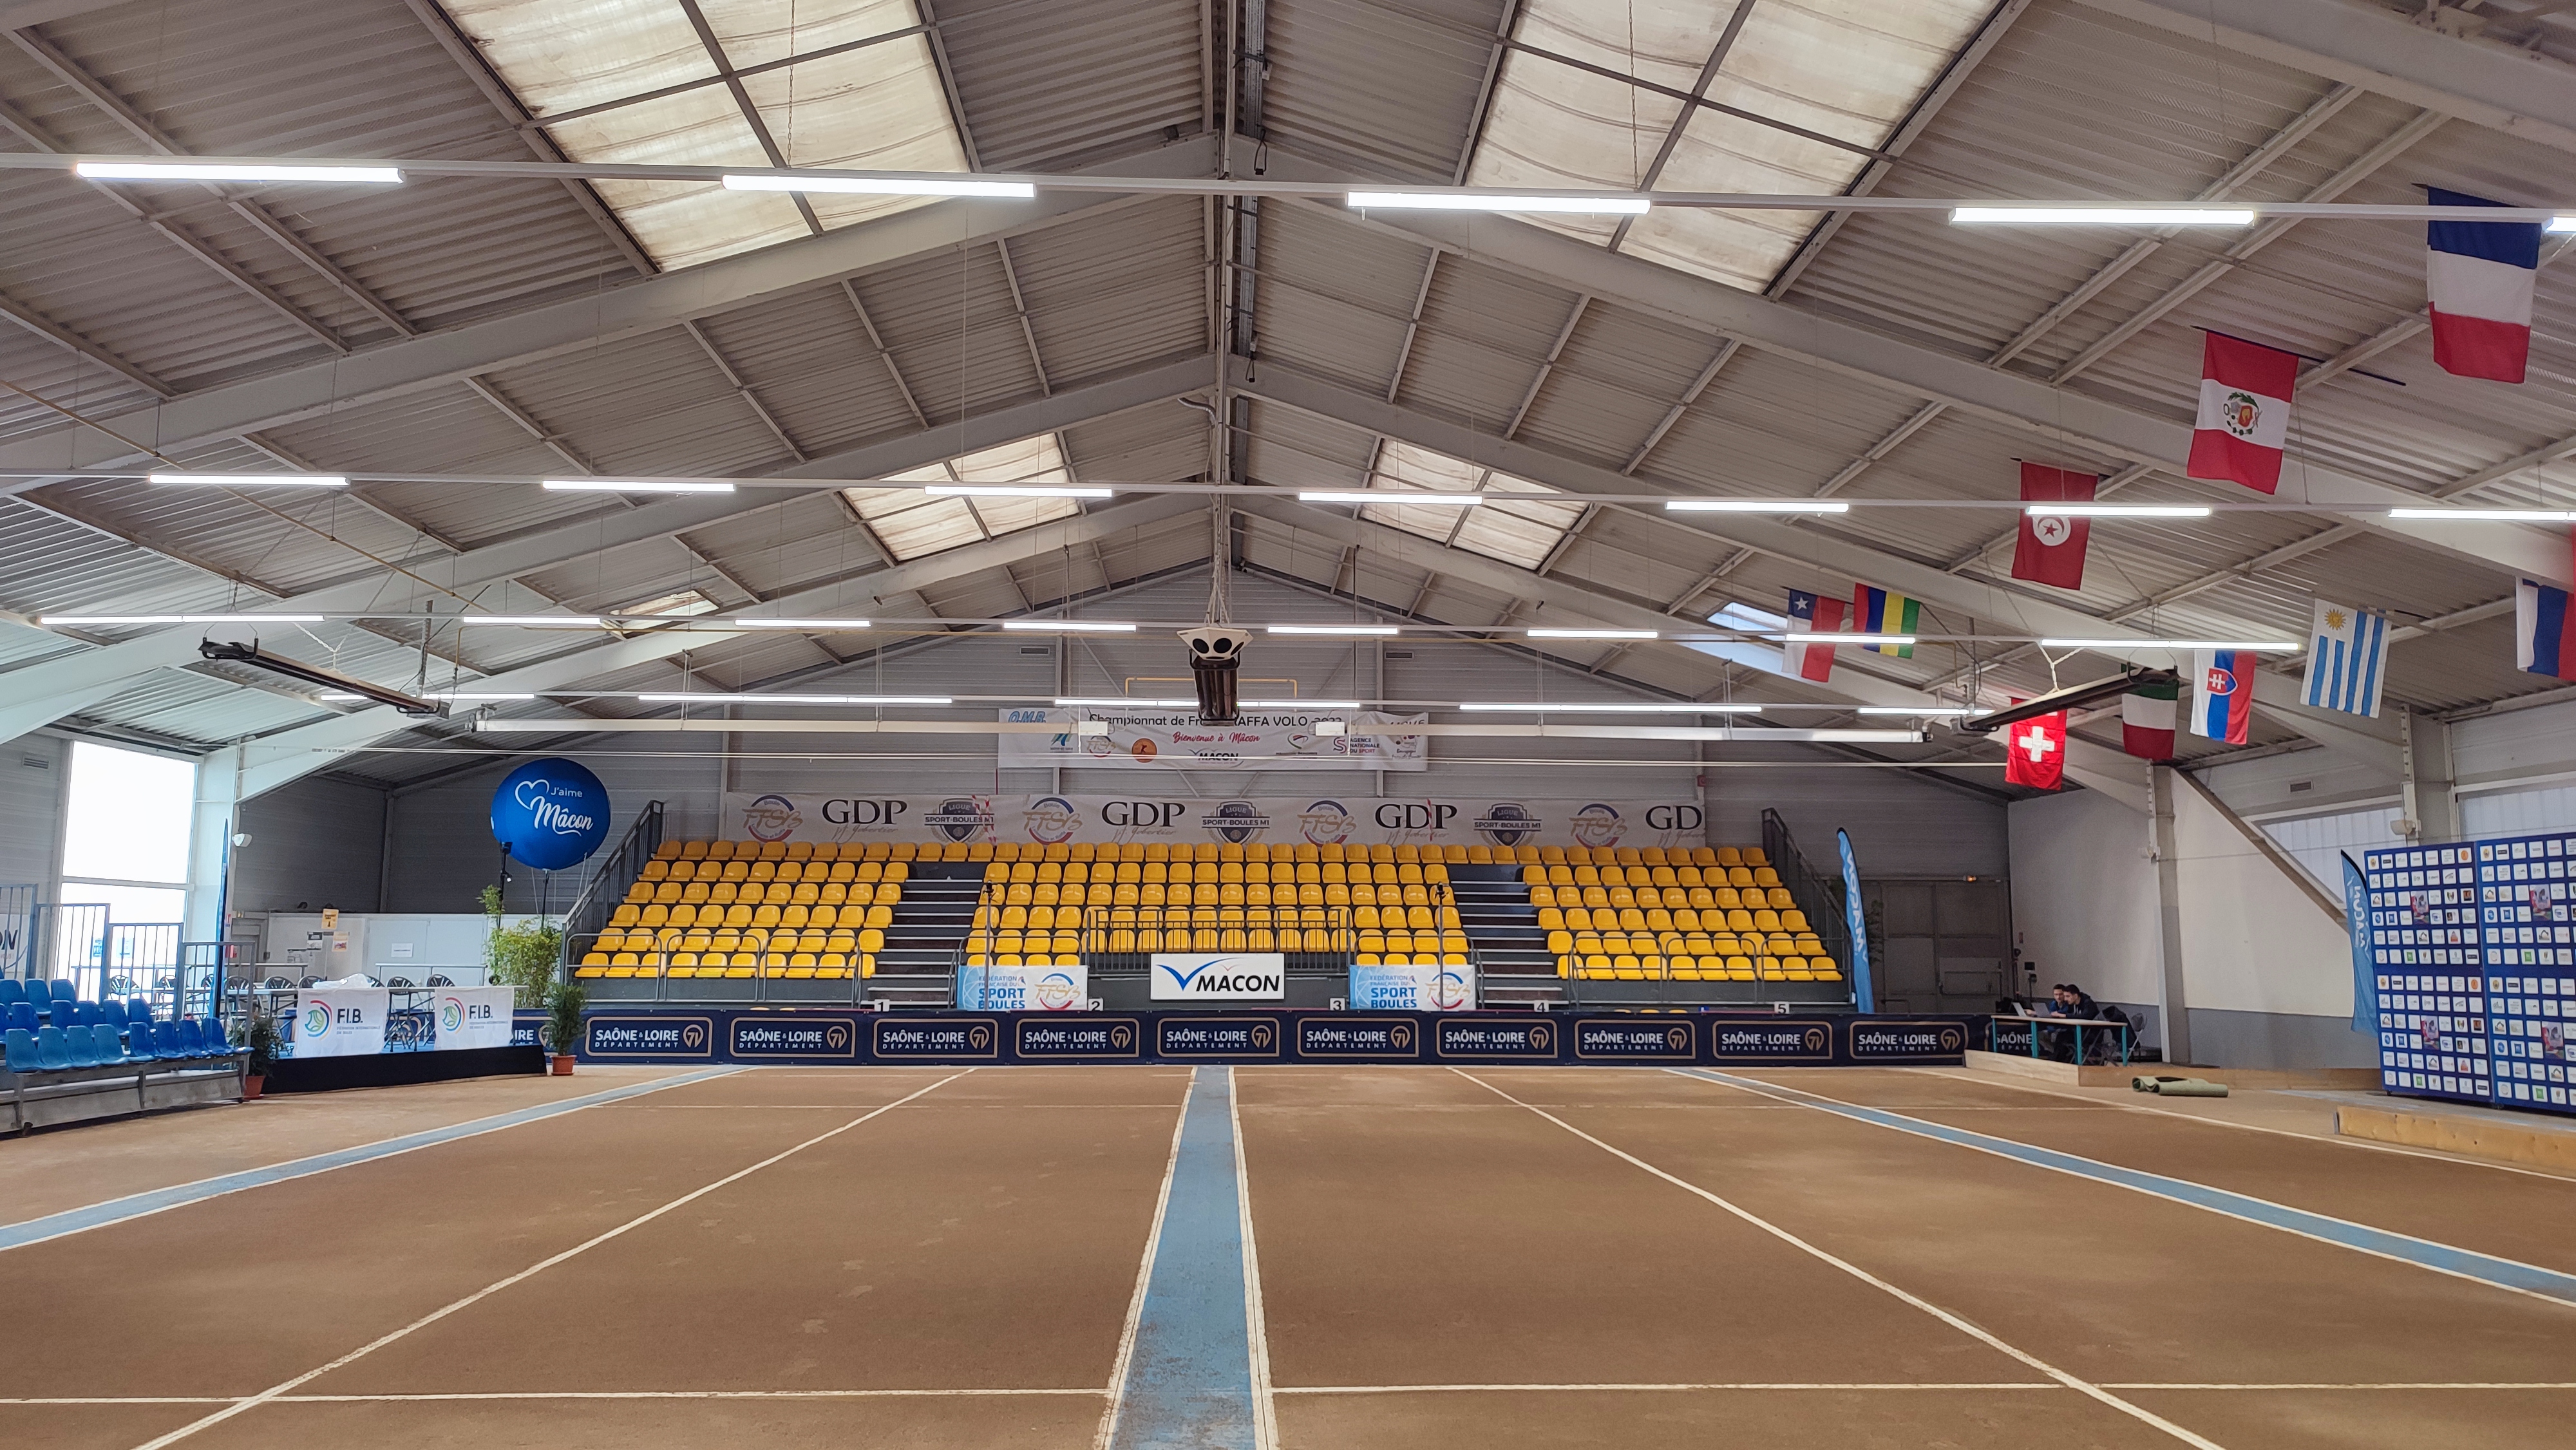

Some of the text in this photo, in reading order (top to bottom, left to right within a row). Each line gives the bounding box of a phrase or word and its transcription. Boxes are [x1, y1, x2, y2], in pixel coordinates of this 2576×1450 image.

[1170, 715, 1185, 726] de
[1273, 716, 1308, 727] VOLO
[1173, 731, 1261, 744] Bienvenue à Mâcon
[550, 787, 583, 798] J'aime
[532, 796, 594, 836] Mâcon
[822, 798, 908, 825] GDP
[1101, 801, 1186, 827] GDP
[1375, 804, 1457, 829] GDP
[1196, 975, 1280, 992] MACON
[978, 988, 1027, 999] SPORT
[1370, 987, 1417, 998] SPORT
[878, 1001, 885, 1011] 1
[978, 1000, 1026, 1010] BOULES
[1091, 1001, 1100, 1011] 2
[1333, 1000, 1342, 1010] 3
[1370, 999, 1417, 1008] BOULES
[1537, 1002, 1546, 1012] 4
[1778, 1003, 1786, 1014] 5
[515, 1030, 535, 1040] IRE
[595, 1027, 638, 1041] SAÔNE
[644, 1030, 679, 1041] LOIRE
[739, 1028, 781, 1042] SAÔNE
[788, 1030, 822, 1042] LOIRE
[883, 1029, 924, 1043] SAÔNE
[931, 1031, 965, 1043] LOIRE
[1025, 1029, 1066, 1043] SAÔNE
[1073, 1031, 1107, 1043] LOIRE
[1166, 1028, 1207, 1042] SAÔNE
[1214, 1030, 1247, 1042] LOIRE
[1307, 1028, 1347, 1042] SAÔNE
[1353, 1031, 1387, 1042] LOIRE
[1445, 1029, 1485, 1043] SAÔNE
[1492, 1031, 1526, 1043] LOIRE
[1584, 1030, 1624, 1044] SAÔNE
[1630, 1032, 1663, 1044] LOIRE
[1721, 1031, 1761, 1045] SAÔNE
[1768, 1033, 1801, 1045] LOIRE
[1859, 1031, 1897, 1045] SAÔNE
[1904, 1034, 1937, 1045] LOIRE
